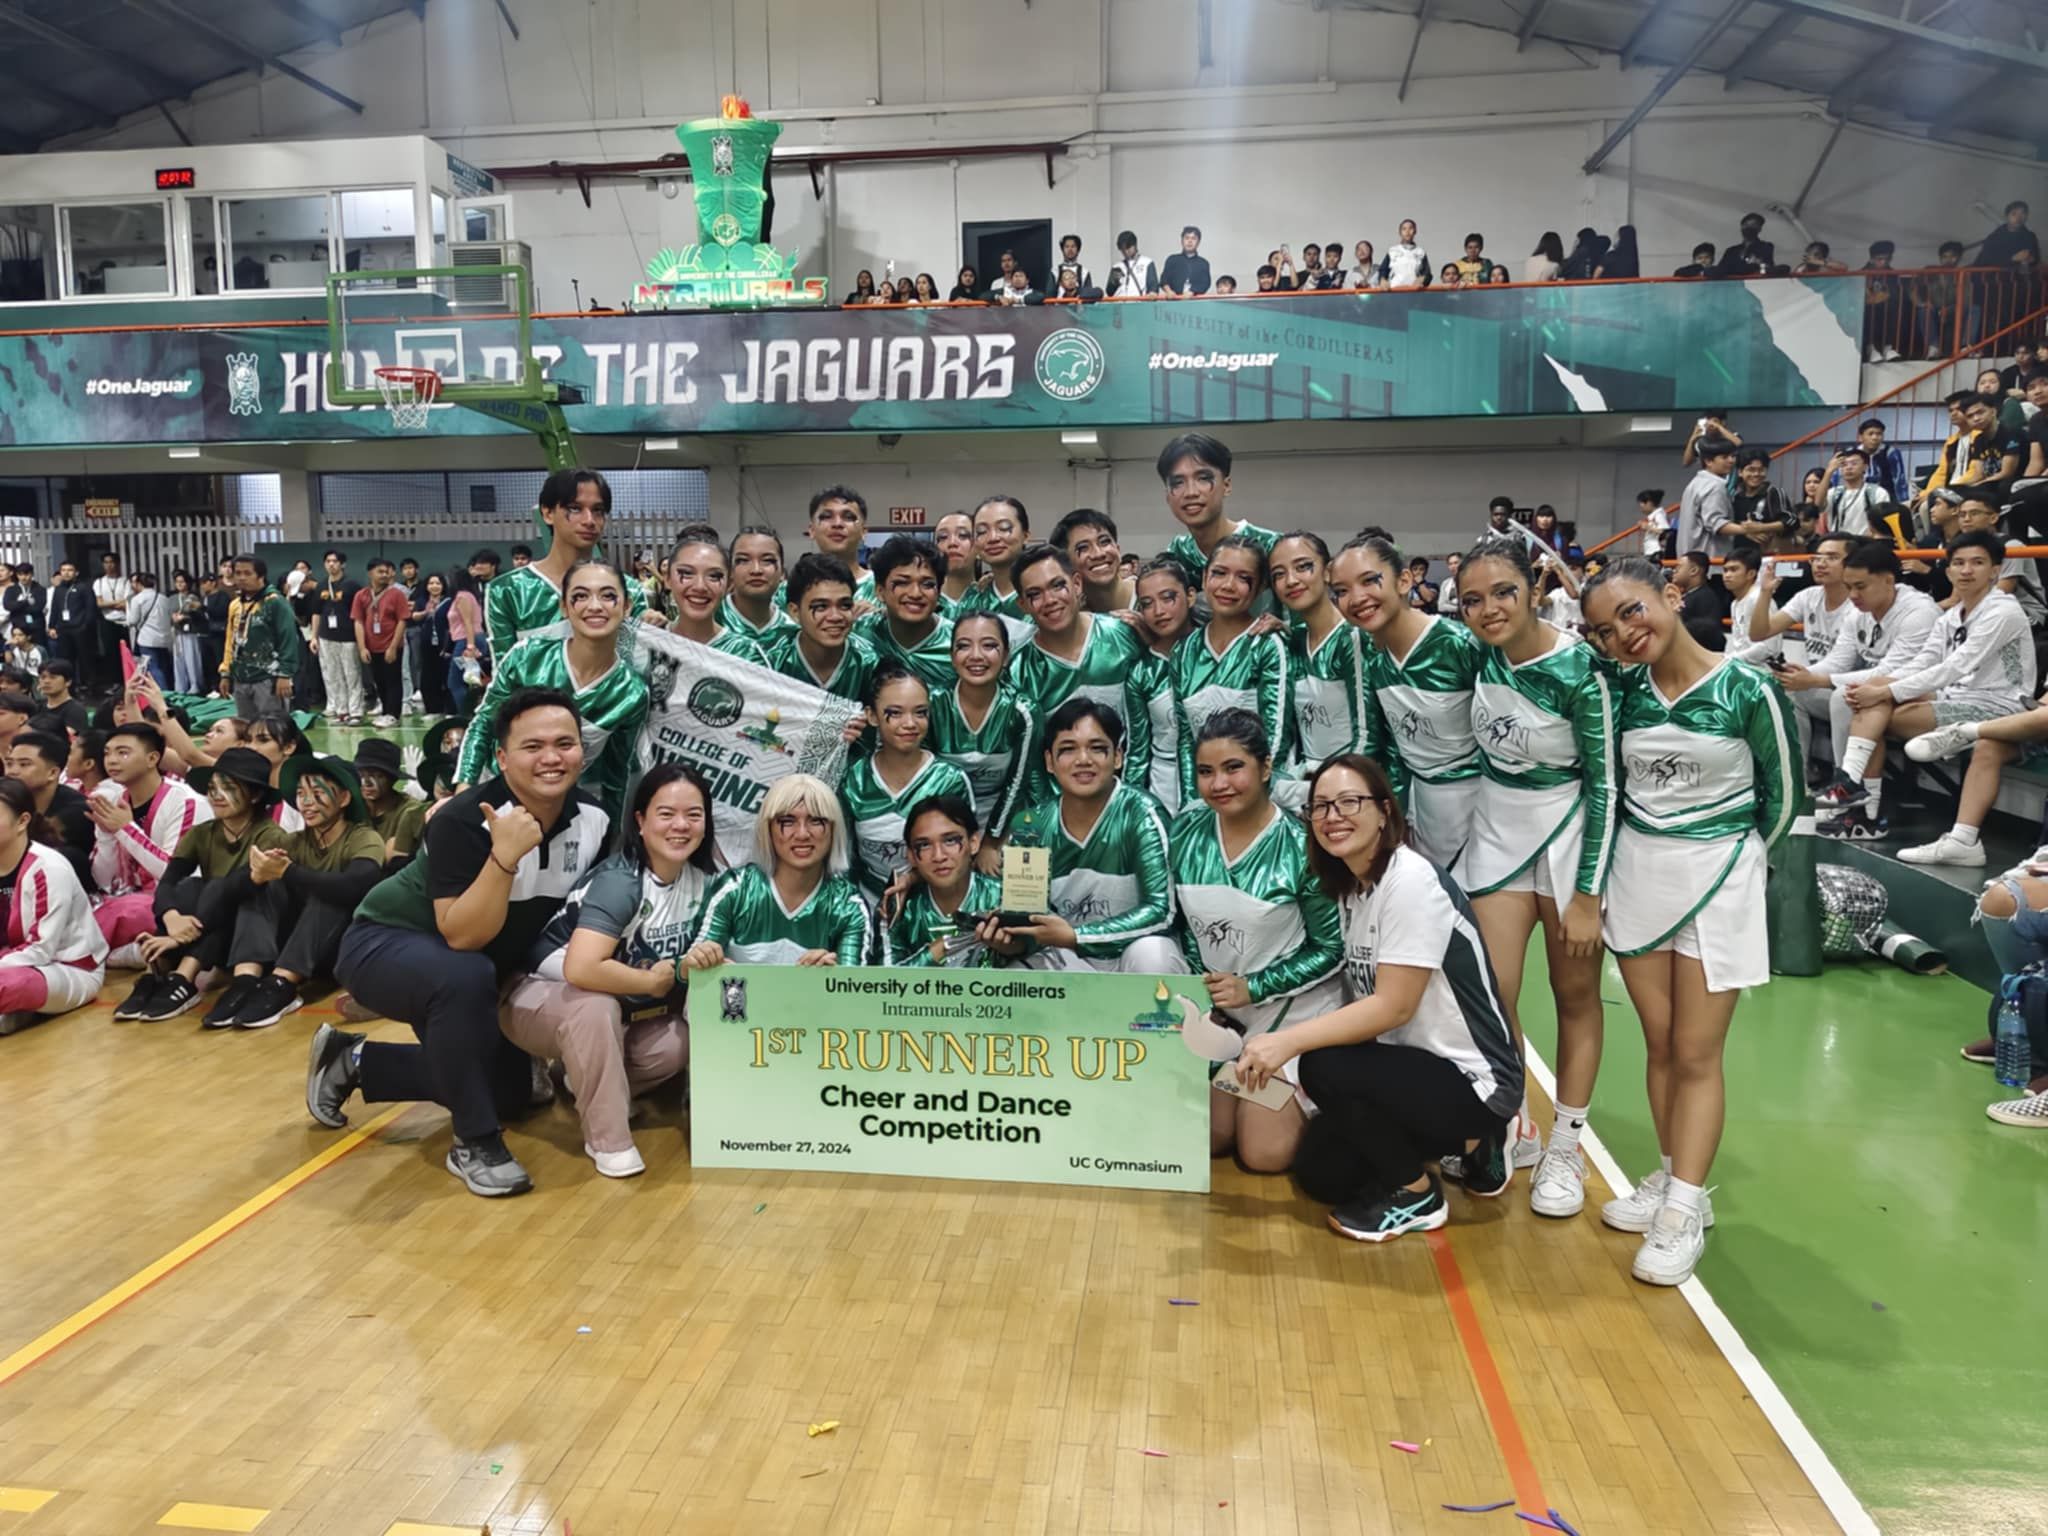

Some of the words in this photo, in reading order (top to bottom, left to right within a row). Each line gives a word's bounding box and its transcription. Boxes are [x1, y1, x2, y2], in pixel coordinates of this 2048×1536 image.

[1285, 328, 1395, 366] CORDILLERAS
[582, 341, 699, 407] THE
[720, 333, 1016, 404] JAGUARS
[1148, 351, 1279, 372] #OneJaguar
[86, 377, 193, 398] #OneJaguar
[1044, 374, 1097, 397] JAGUARS
[892, 508, 923, 524] EXIT
[659, 726, 728, 763] COLLEGE
[727, 752, 753, 770] OF
[825, 977, 908, 999] University
[913, 980, 930, 995] of
[935, 980, 963, 996] the
[969, 981, 1066, 999] Cordilleras
[882, 1001, 972, 1018] Intramurals
[975, 1004, 1012, 1019] 2024
[749, 1027, 806, 1068] 1ST
[818, 1028, 1054, 1079] RUNNER
[1067, 1036, 1148, 1082] UP
[820, 1085, 905, 1109] Cheer
[913, 1090, 968, 1112] and
[978, 1091, 1072, 1117] Dance
[859, 1114, 1041, 1144] Competition
[720, 1139, 793, 1152] November
[796, 1141, 815, 1155] 27,
[818, 1142, 852, 1154] 2024
[1069, 1156, 1091, 1169] UC
[1094, 1157, 1183, 1174] Gymnasium
